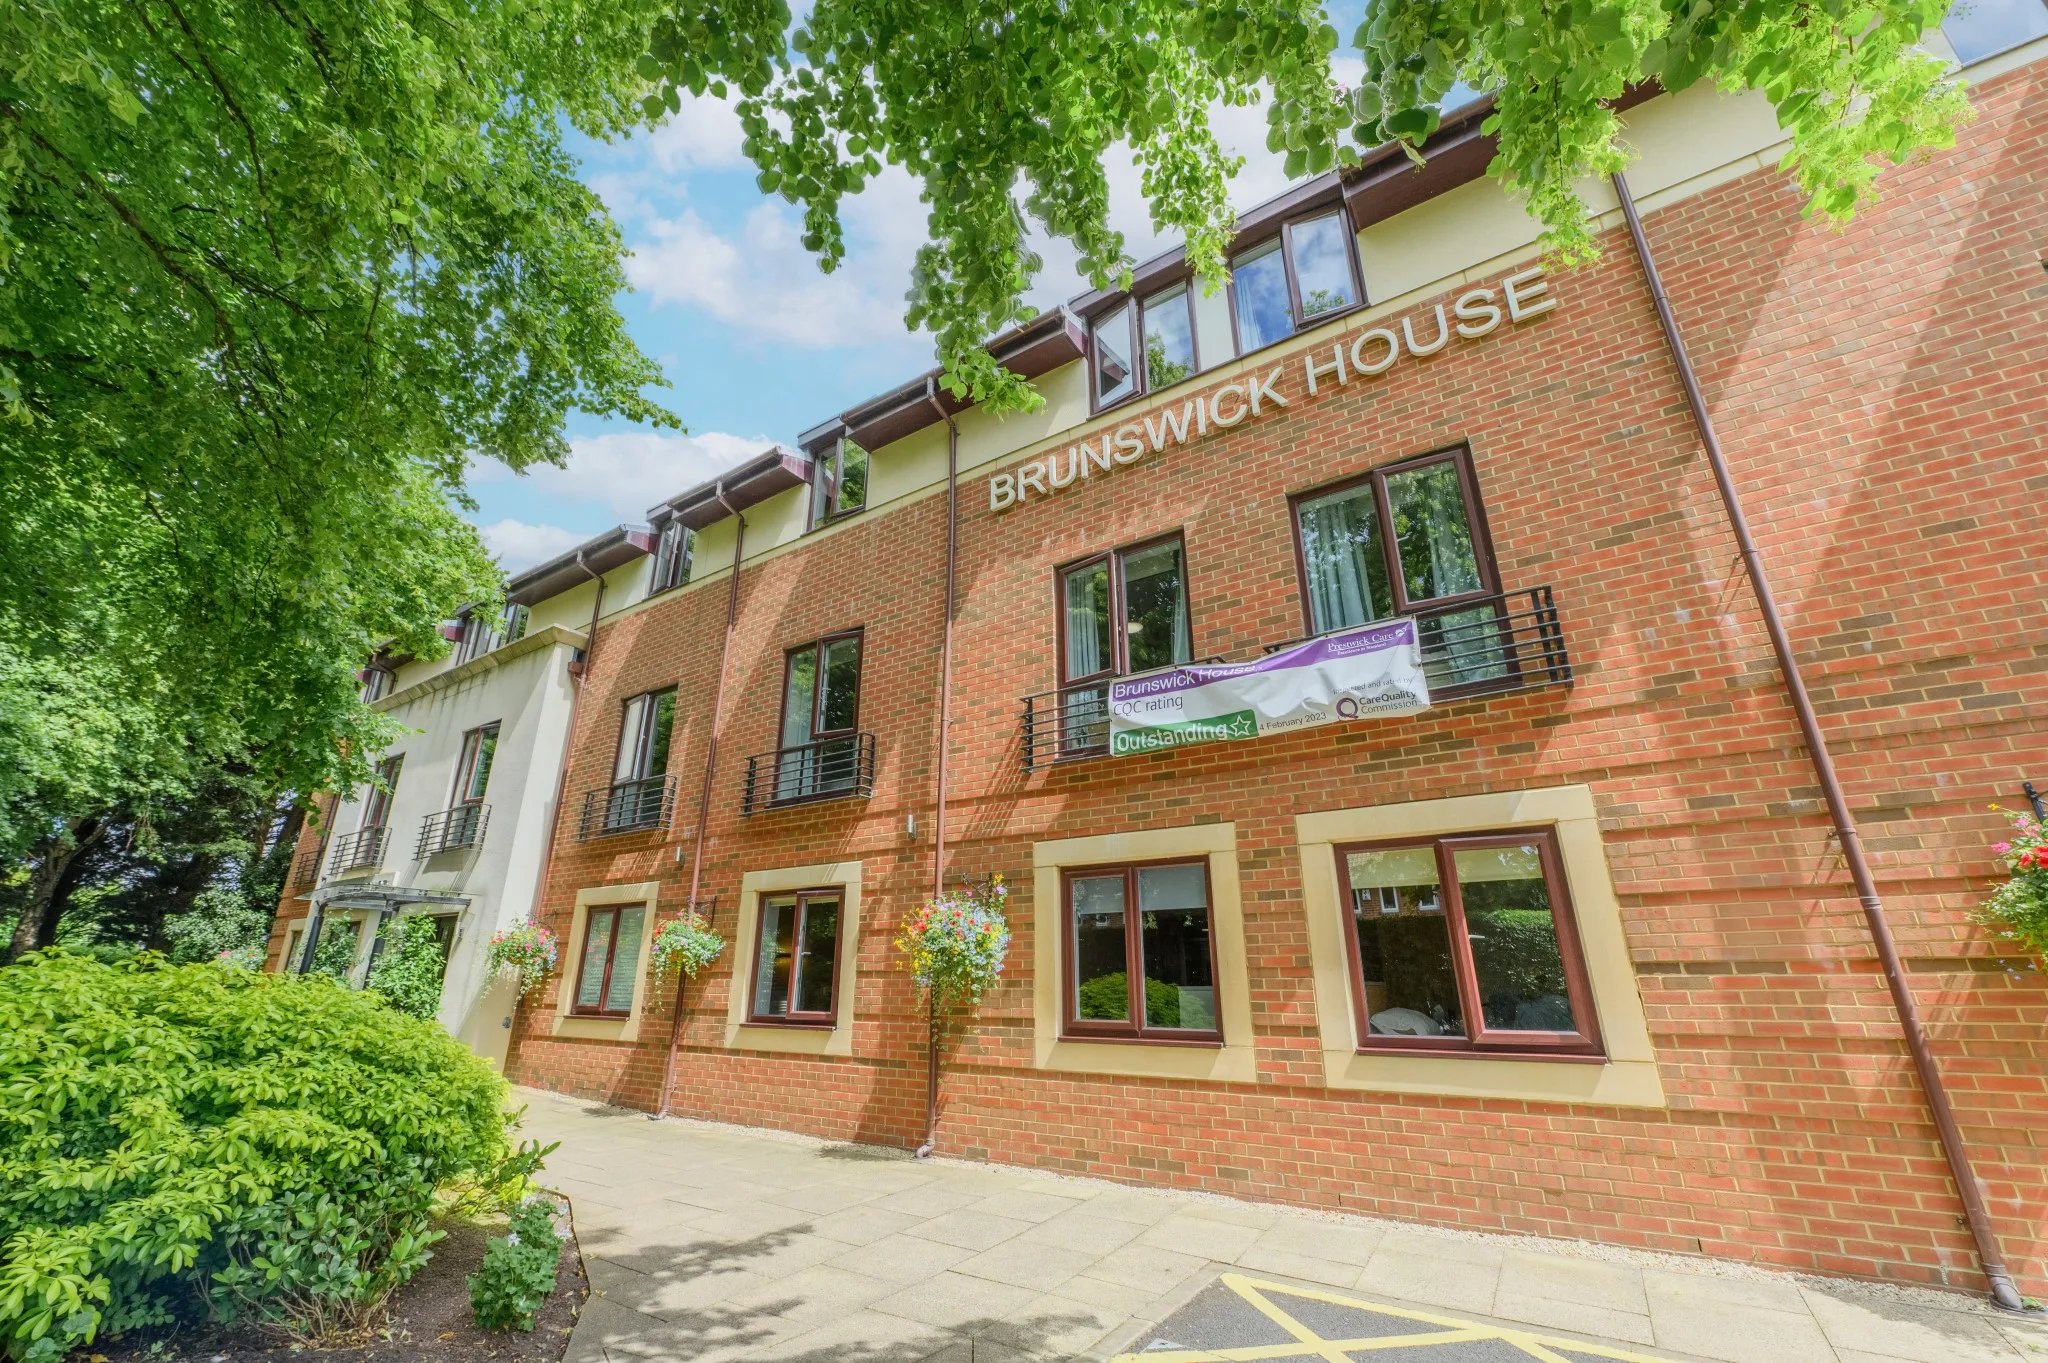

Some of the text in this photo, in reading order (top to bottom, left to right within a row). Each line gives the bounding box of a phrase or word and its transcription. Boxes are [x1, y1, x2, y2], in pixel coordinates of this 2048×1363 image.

[989, 266, 1558, 512] BRUNSWICK HOUSE
[1328, 632, 1393, 652] Prestwick Care
[1115, 671, 1196, 698] Brunswick
[1367, 680, 1380, 688] and
[1113, 695, 1183, 716] CQC rating
[1361, 699, 1418, 714] Commission
[1266, 717, 1303, 730] February
[1304, 712, 1327, 723] 2023
[1116, 723, 1227, 751] Outstanding
